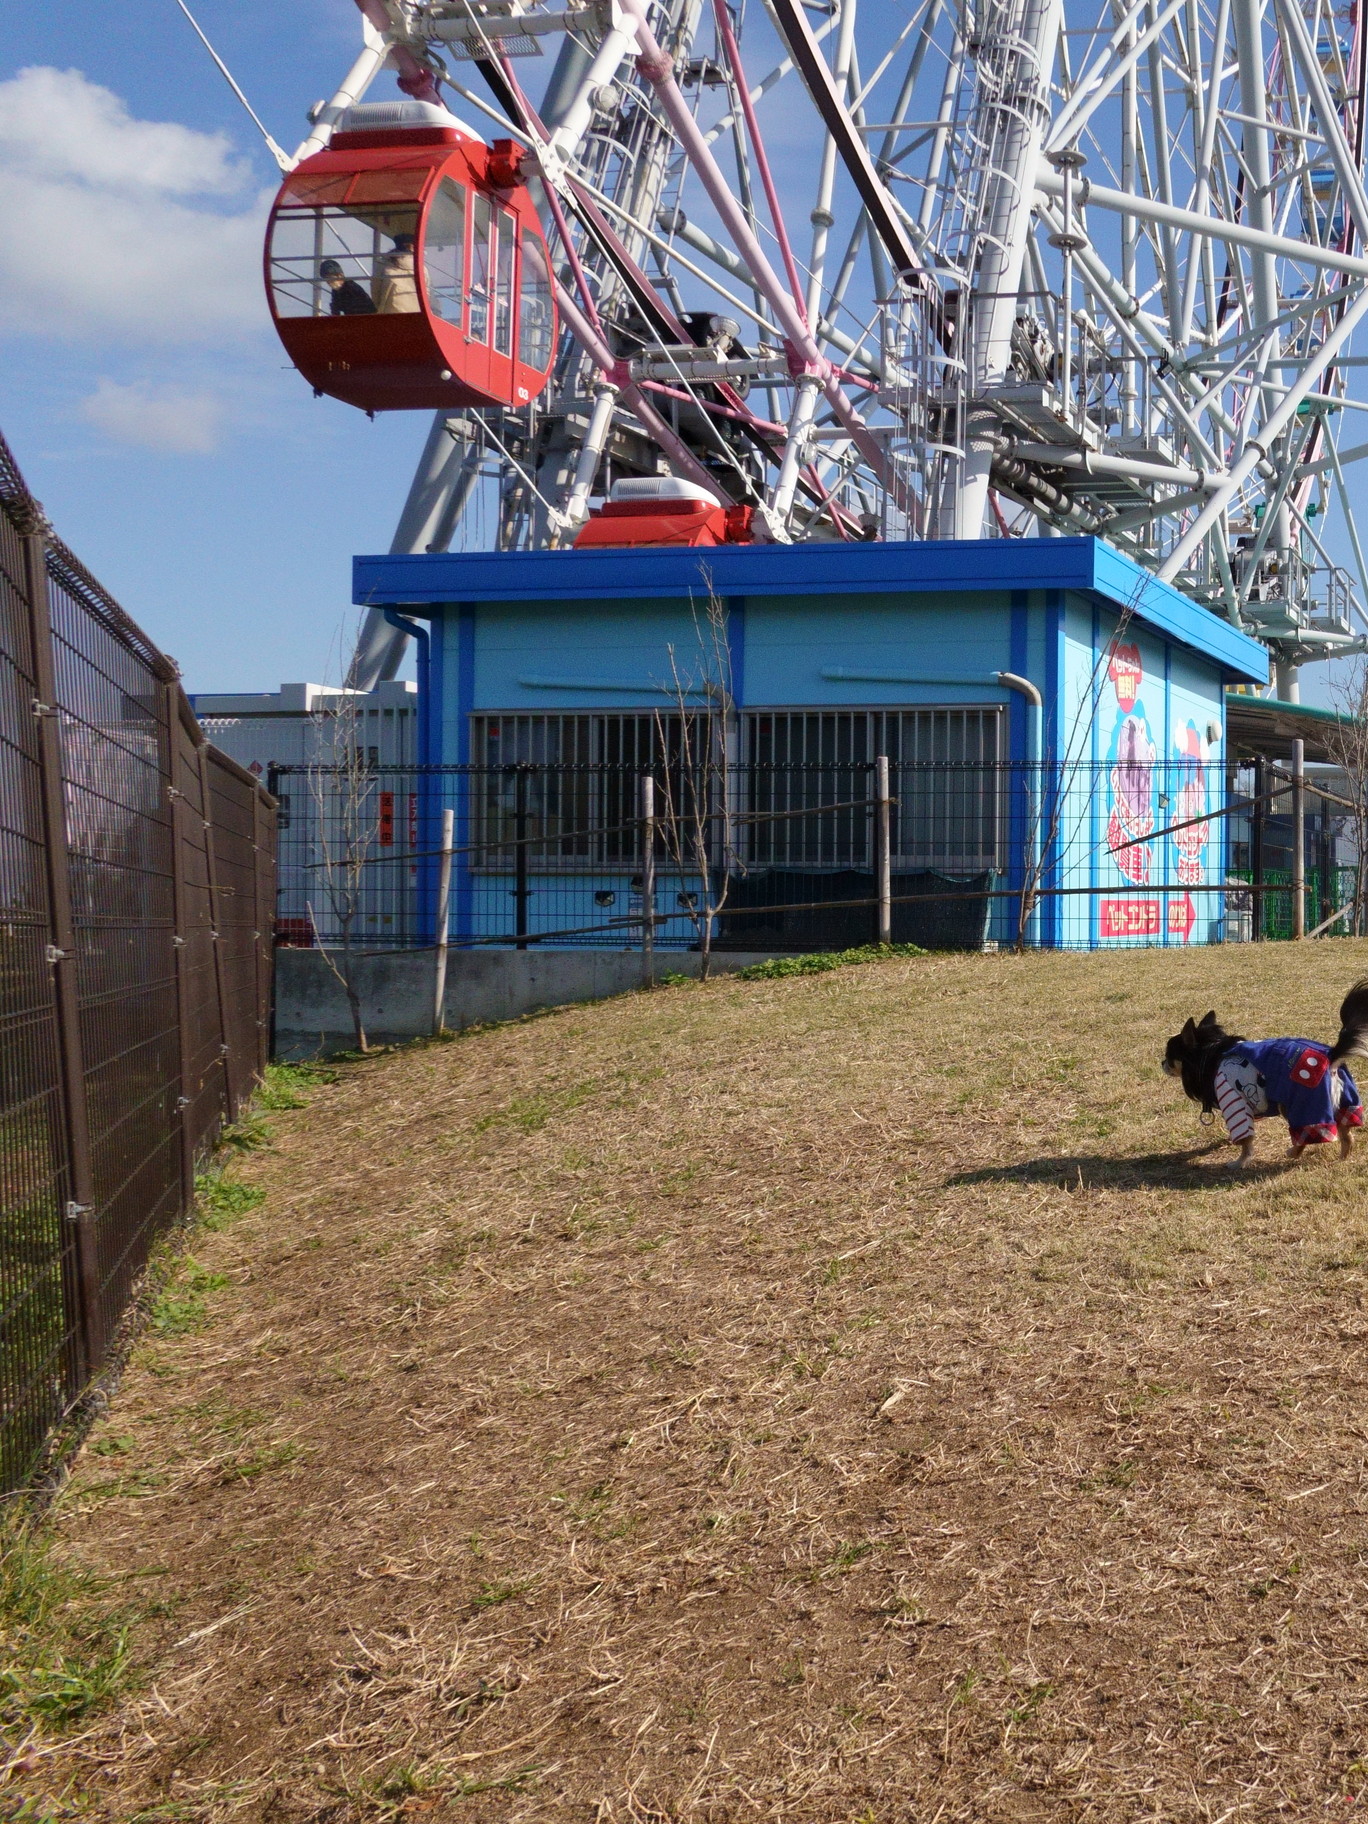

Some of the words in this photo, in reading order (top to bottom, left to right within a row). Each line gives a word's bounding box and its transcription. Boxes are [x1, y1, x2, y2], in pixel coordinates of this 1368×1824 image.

[1106, 903, 1156, 931] ペットゴンドラ
